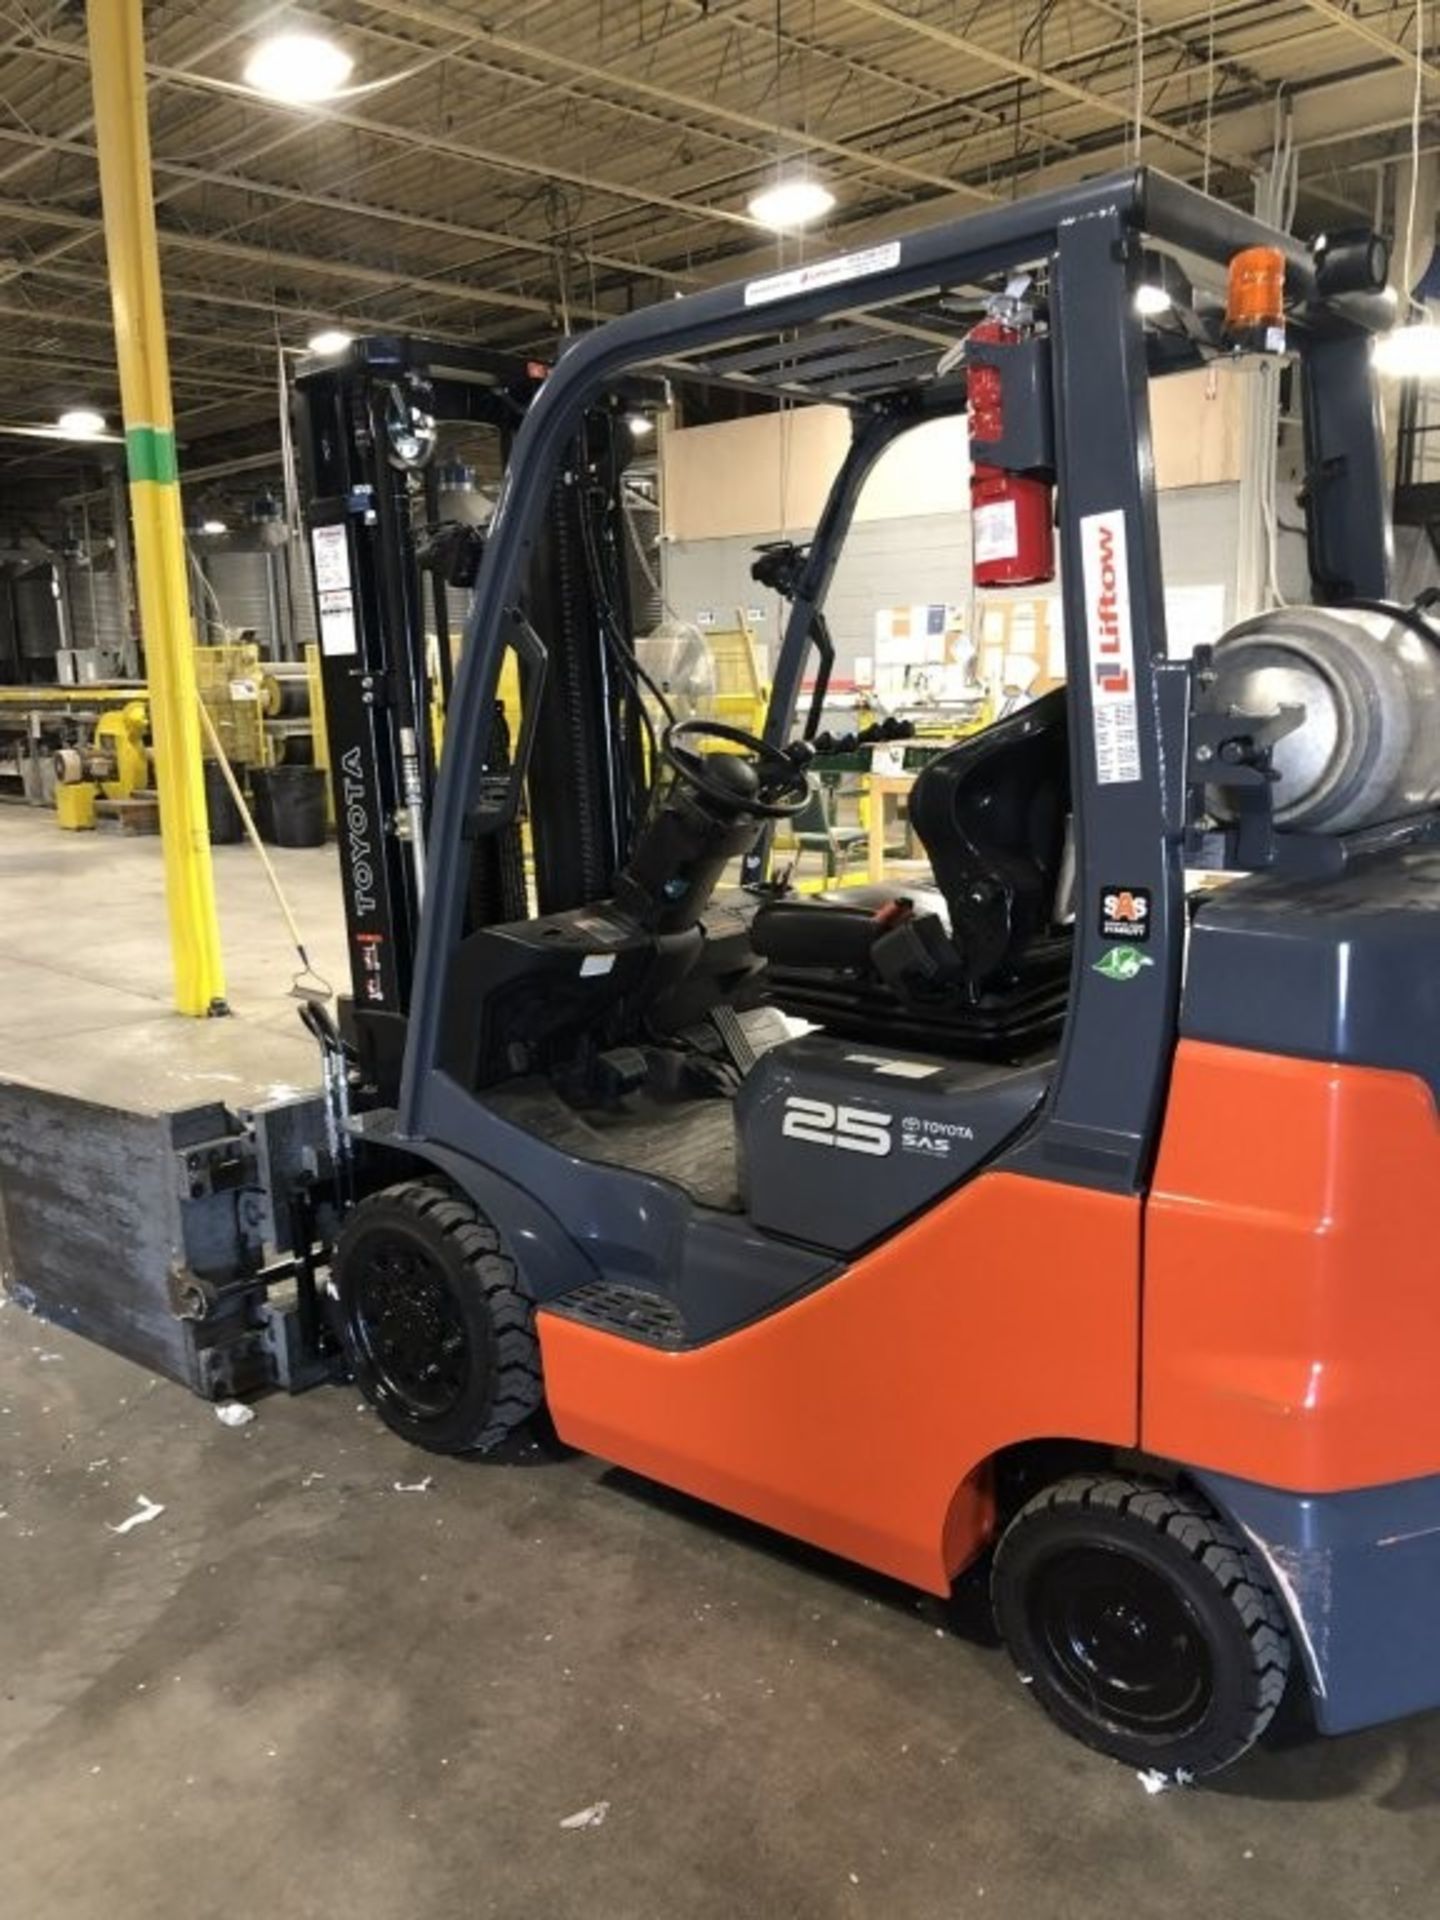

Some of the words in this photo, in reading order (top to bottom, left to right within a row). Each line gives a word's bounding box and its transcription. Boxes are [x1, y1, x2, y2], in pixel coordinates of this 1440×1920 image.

[1098, 527, 1120, 653] Liftow
[342, 746, 376, 916] TOYOTA
[1103, 892, 1147, 921] SAS
[782, 1096, 893, 1156] 25
[901, 1134, 950, 1151] SAS
[922, 1121, 974, 1140] TOYOTA
